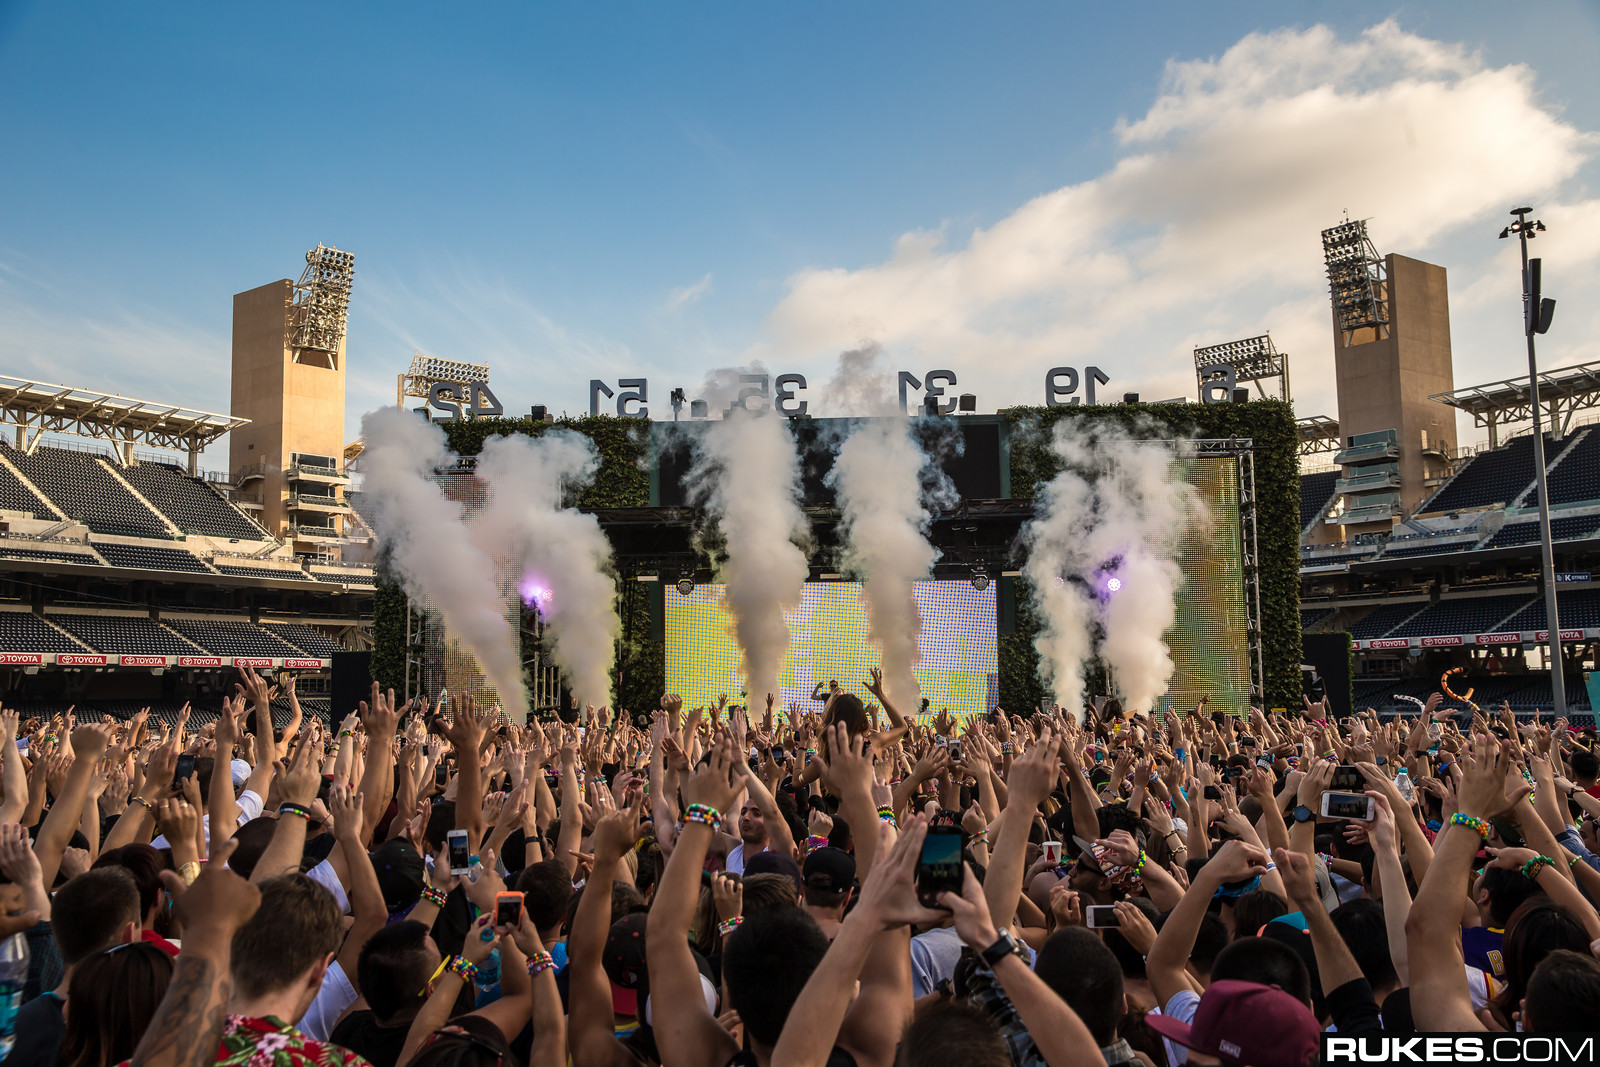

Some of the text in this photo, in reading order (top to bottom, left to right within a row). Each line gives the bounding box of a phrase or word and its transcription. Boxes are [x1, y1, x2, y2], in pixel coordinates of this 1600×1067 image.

[1490, 634, 1517, 642] TOYOTA
[1560, 631, 1580, 639] YOTA
[1434, 637, 1460, 645] TOYOTA
[7, 655, 38, 663] TOYOTA
[74, 656, 103, 664] TOYOTA
[136, 657, 163, 665] TOYOTA
